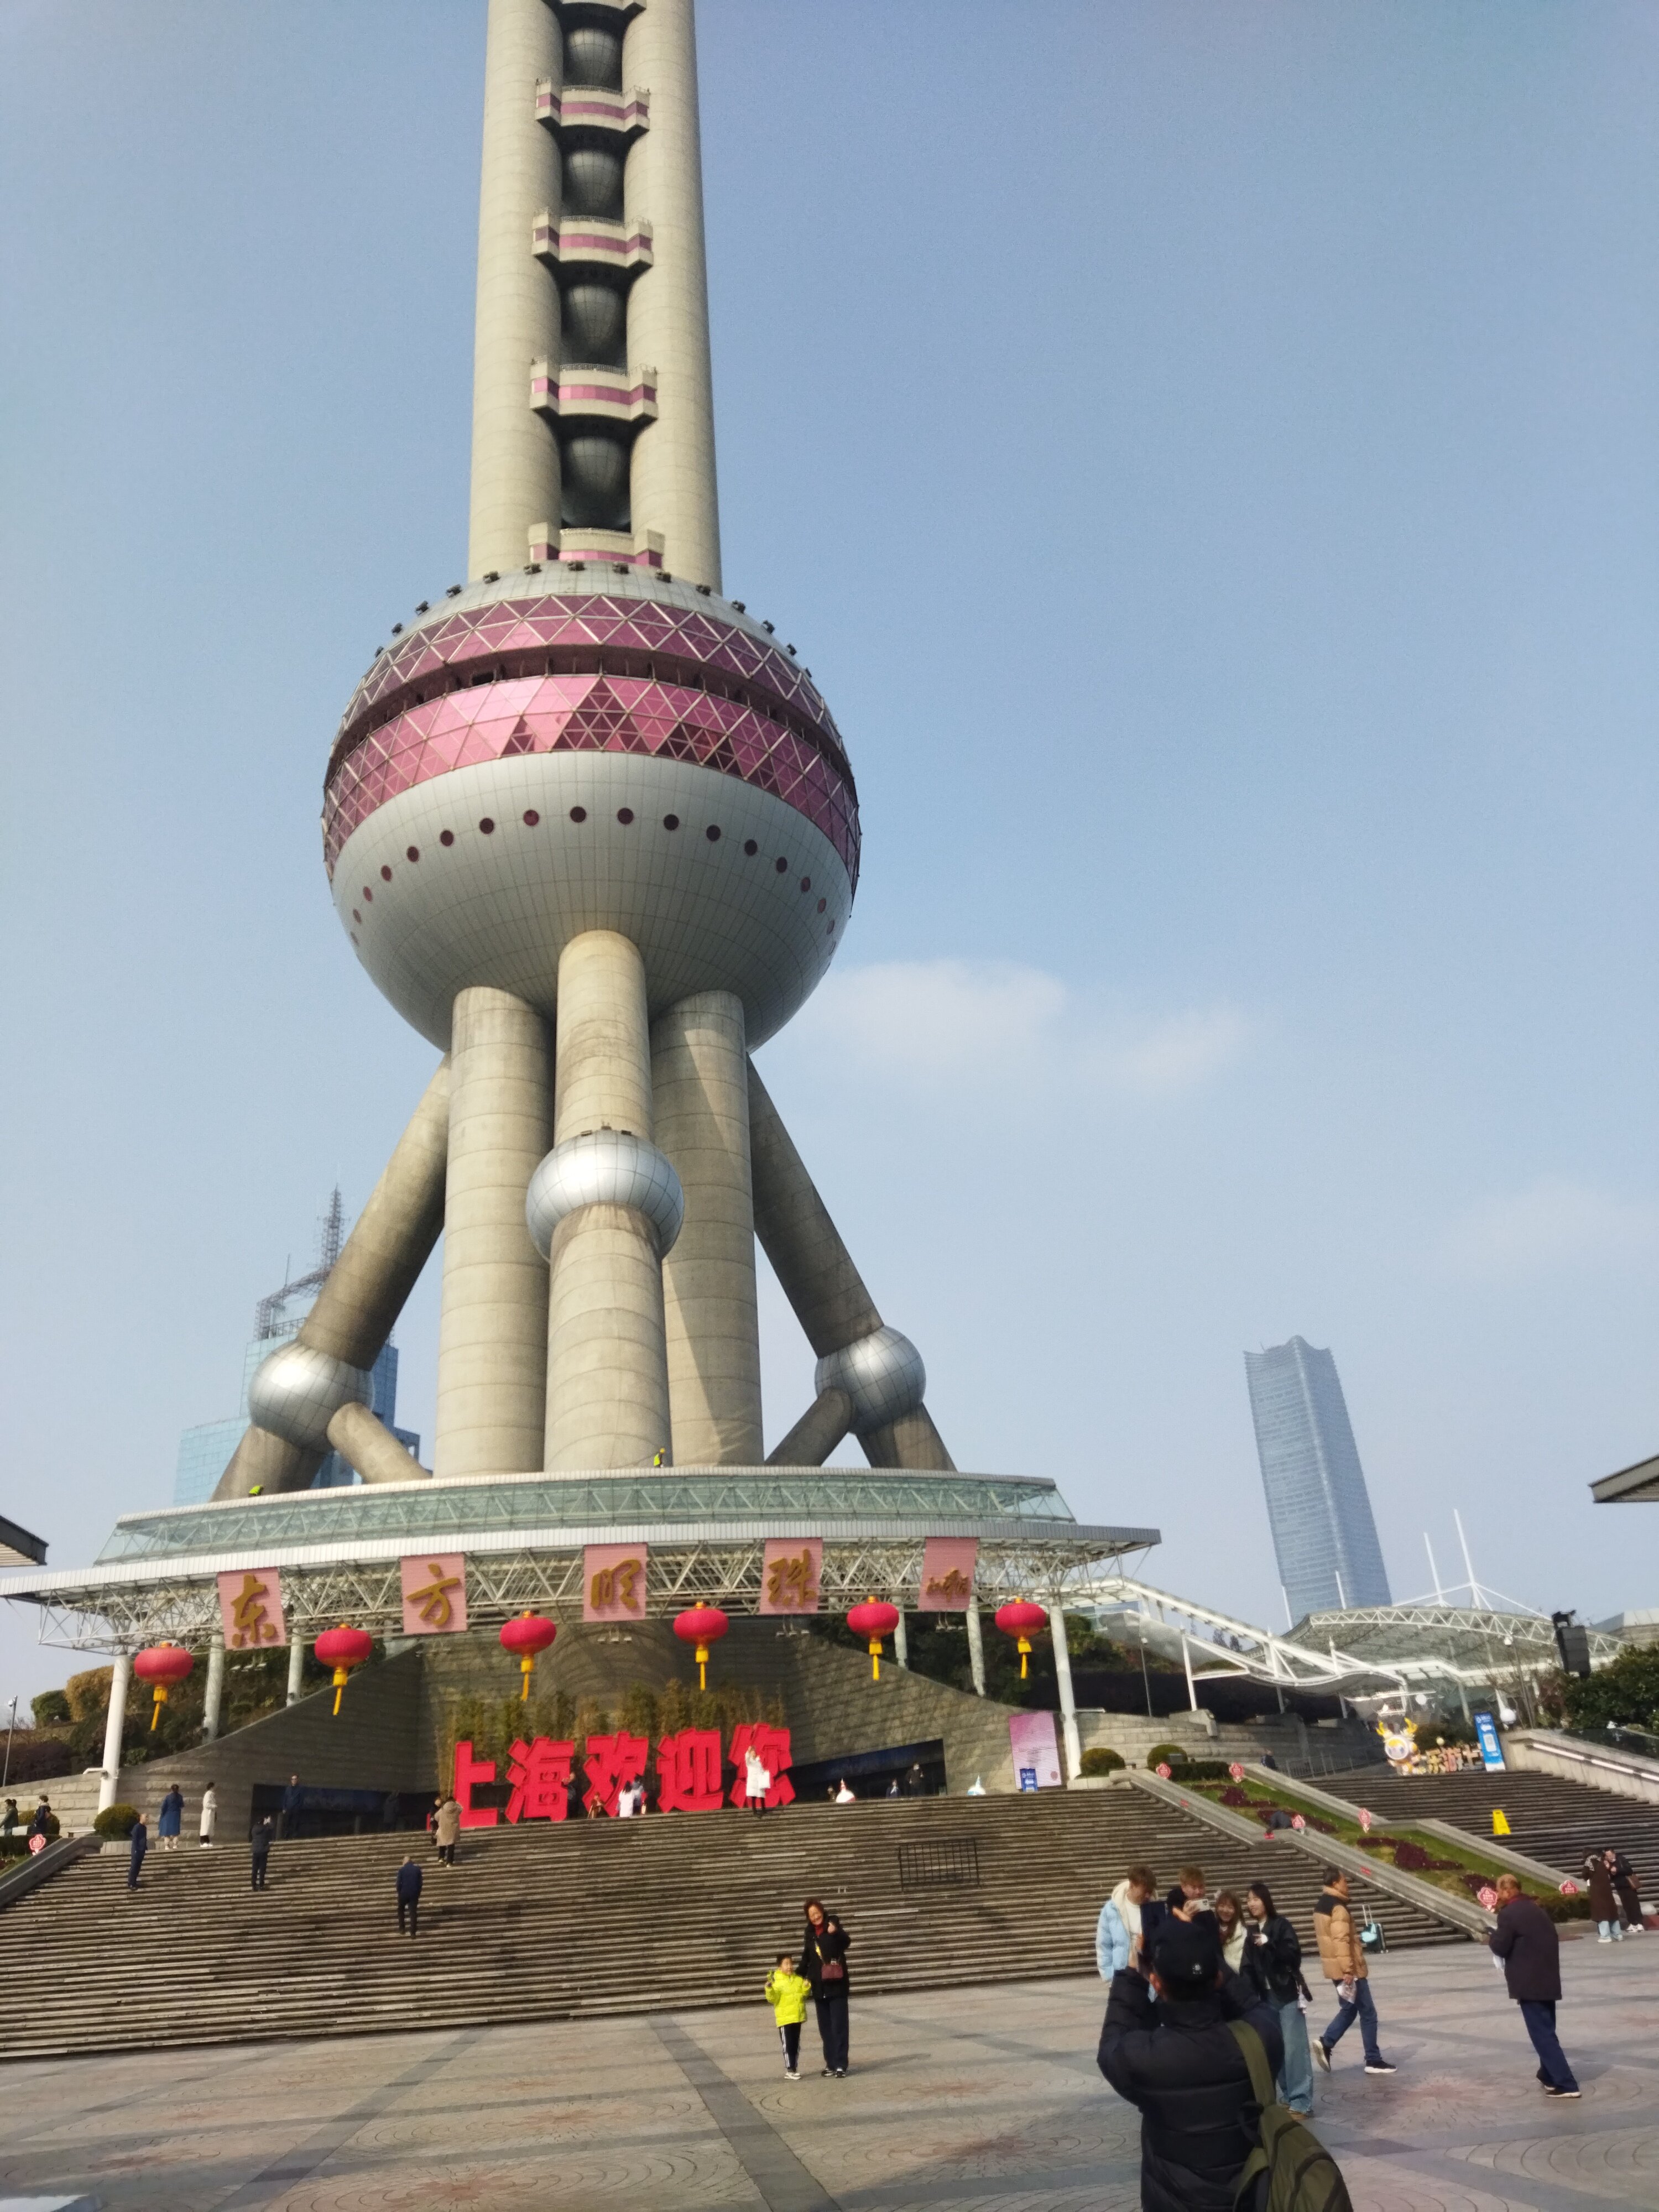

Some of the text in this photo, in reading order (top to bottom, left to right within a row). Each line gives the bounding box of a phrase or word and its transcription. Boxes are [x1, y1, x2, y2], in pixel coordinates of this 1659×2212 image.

[231, 1548, 817, 1647] 东方明珠
[426, 1723, 796, 1831] 上海欢迎您
